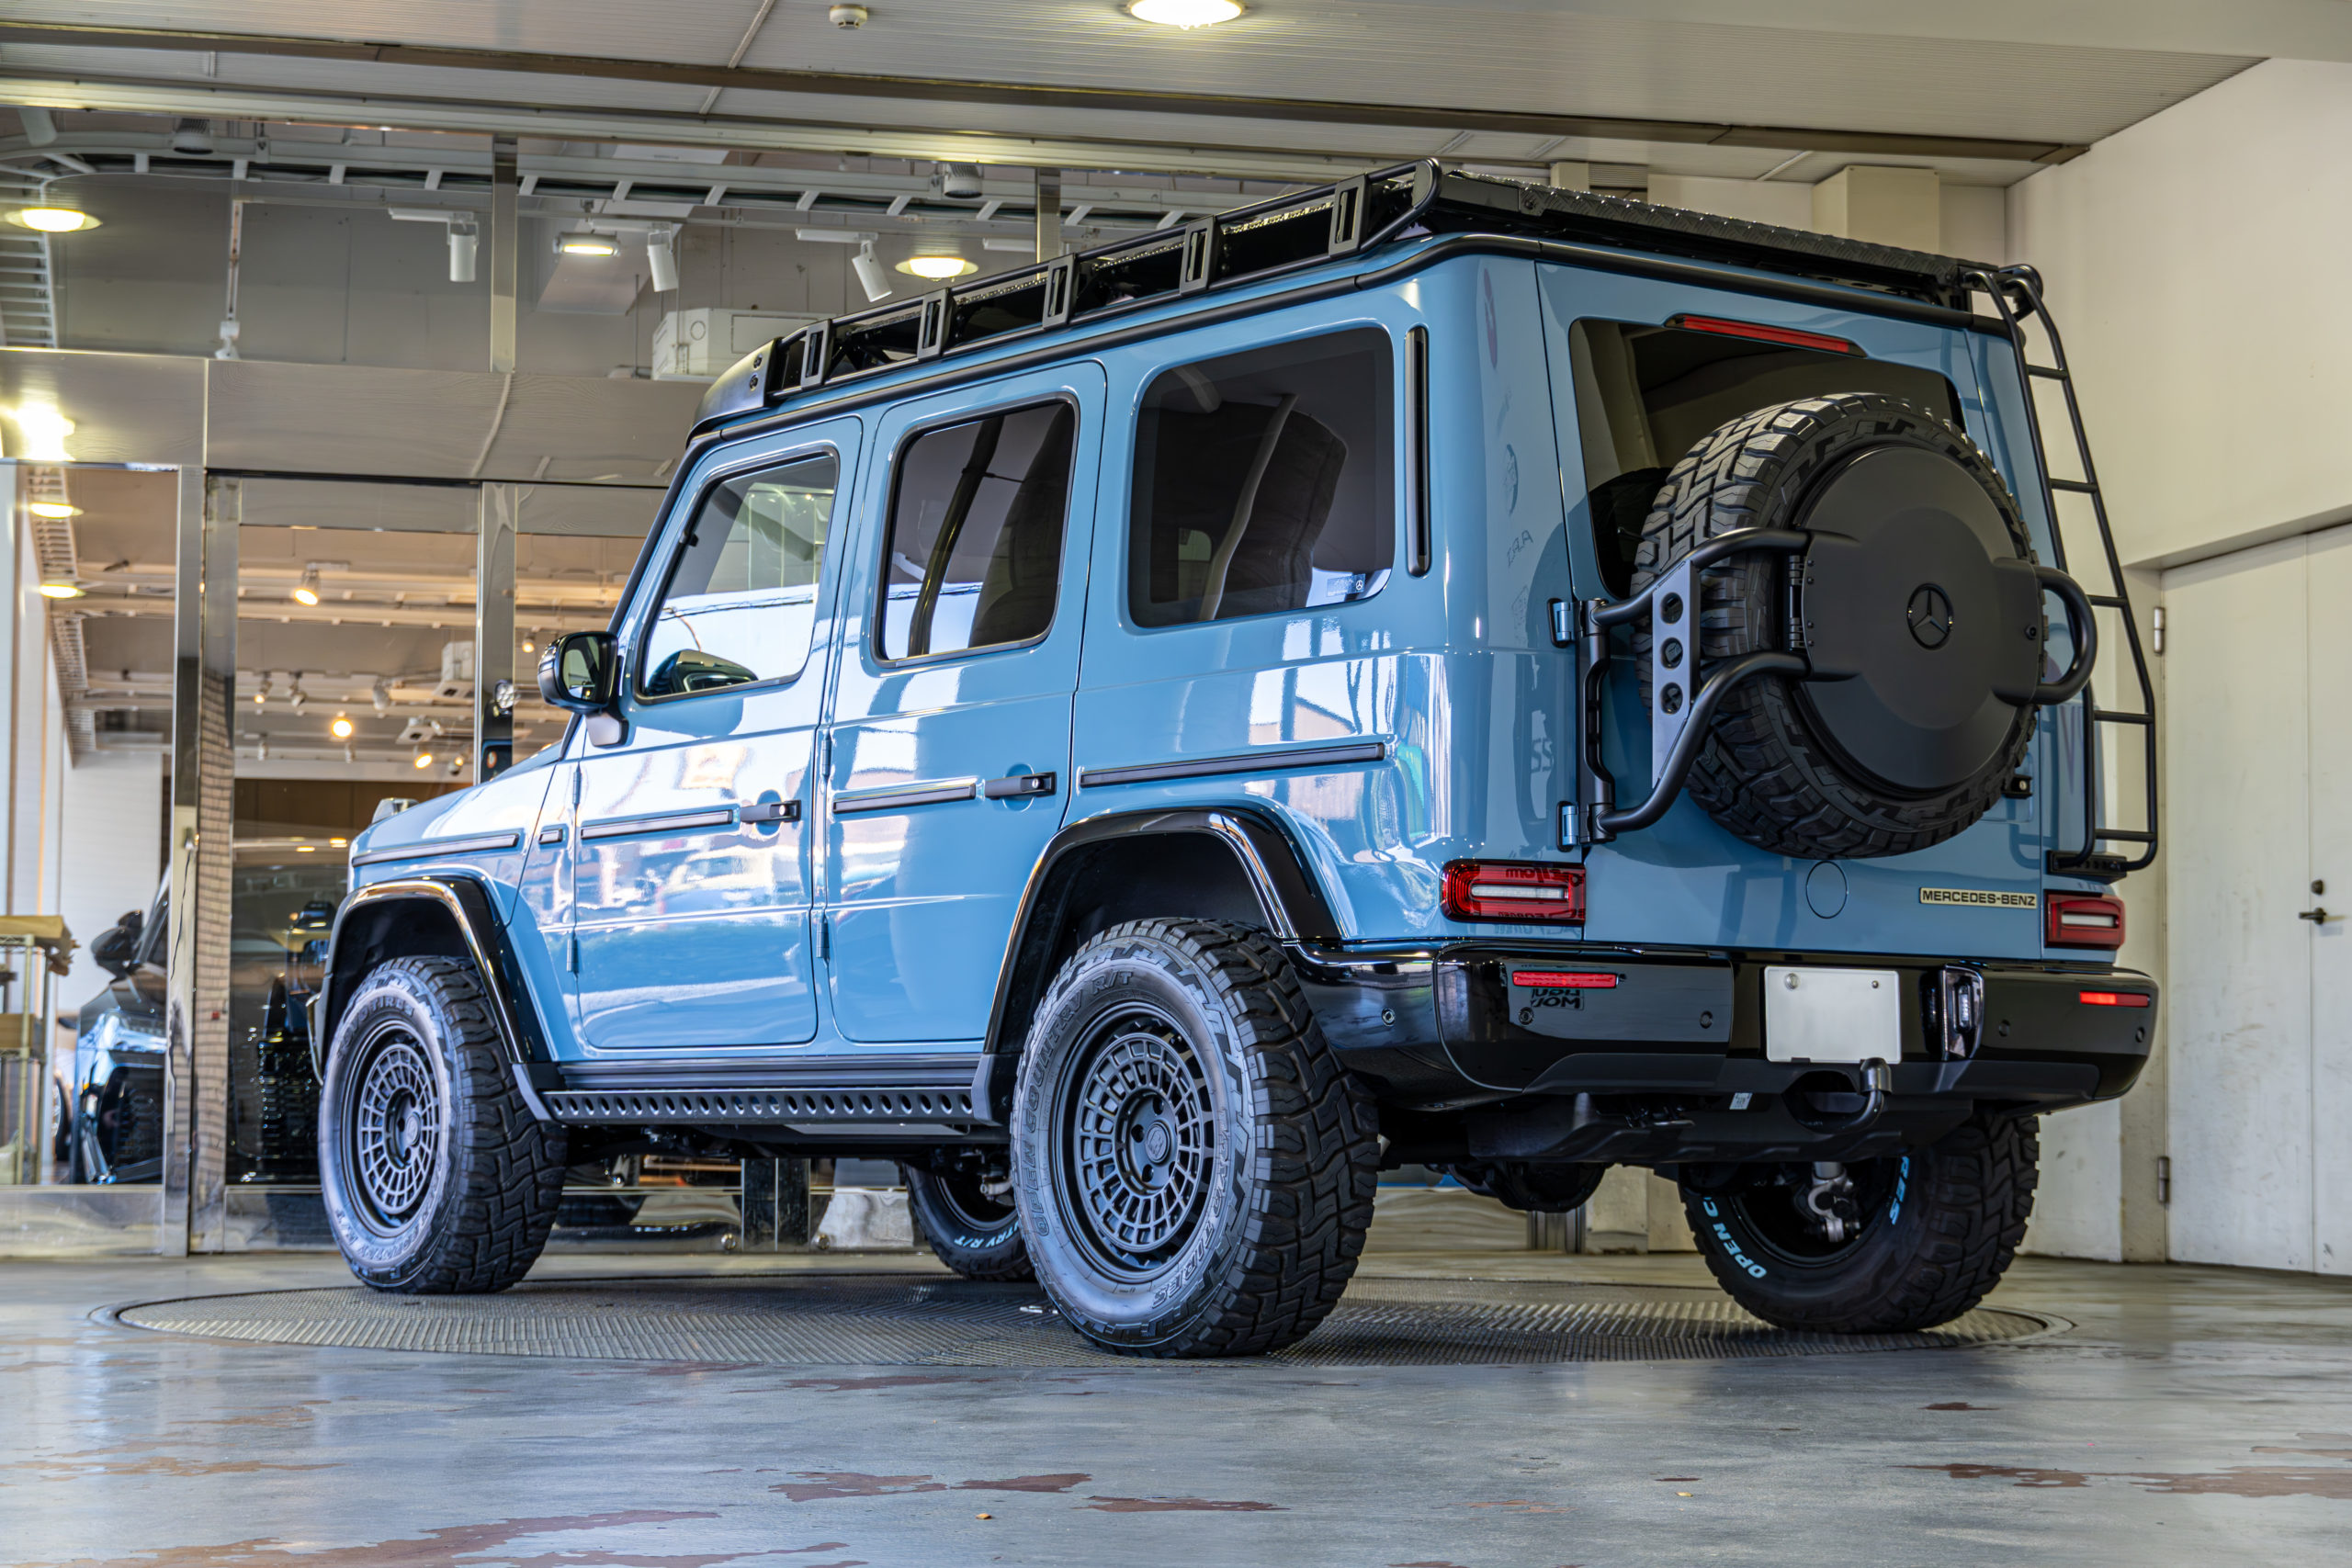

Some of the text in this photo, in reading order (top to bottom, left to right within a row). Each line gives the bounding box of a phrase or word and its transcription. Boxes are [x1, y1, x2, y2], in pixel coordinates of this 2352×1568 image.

[1922, 889, 2036, 907] MERCEDES-BENZ
[1023, 970, 1134, 1236] OPEN COUNTRY R/T
[954, 1235, 986, 1249] R/T
[1151, 1220, 1215, 1309] TIRES
[1712, 1222, 1768, 1279] OPEN
